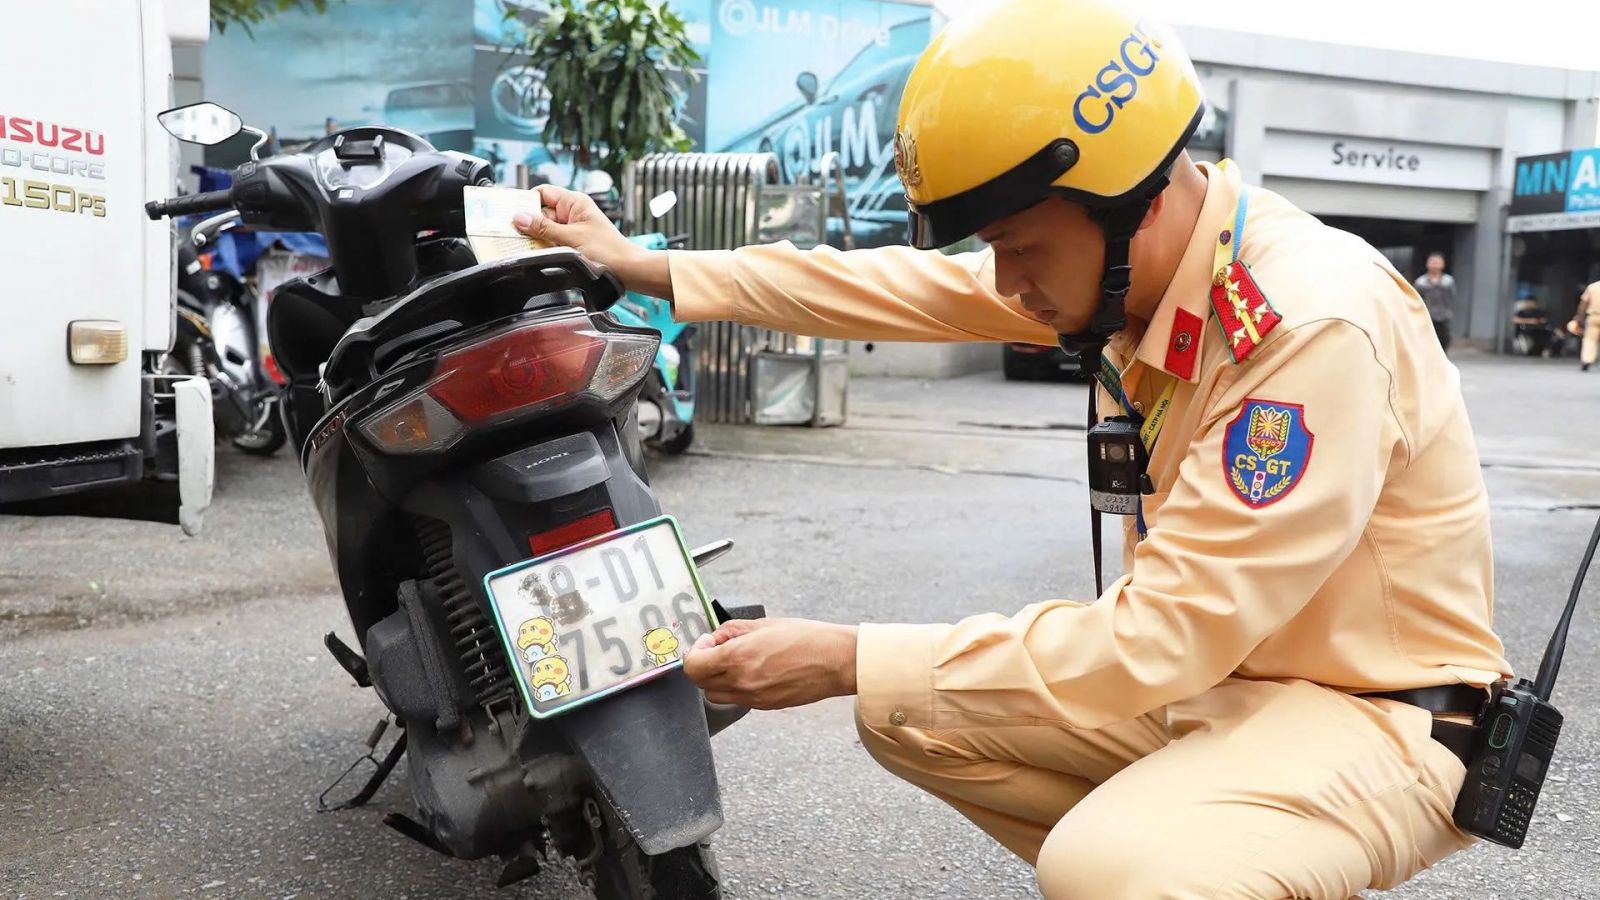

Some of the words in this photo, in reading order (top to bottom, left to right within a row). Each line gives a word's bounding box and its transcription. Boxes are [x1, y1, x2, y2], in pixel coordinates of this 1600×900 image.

[1073, 30, 1162, 134] CSG
[0, 115, 104, 156] ISUZU
[1332, 141, 1420, 171] Service
[1516, 159, 1568, 195] MN
[1571, 154, 1600, 191] A
[1234, 453, 1257, 471] CS
[1266, 458, 1291, 476] GT
